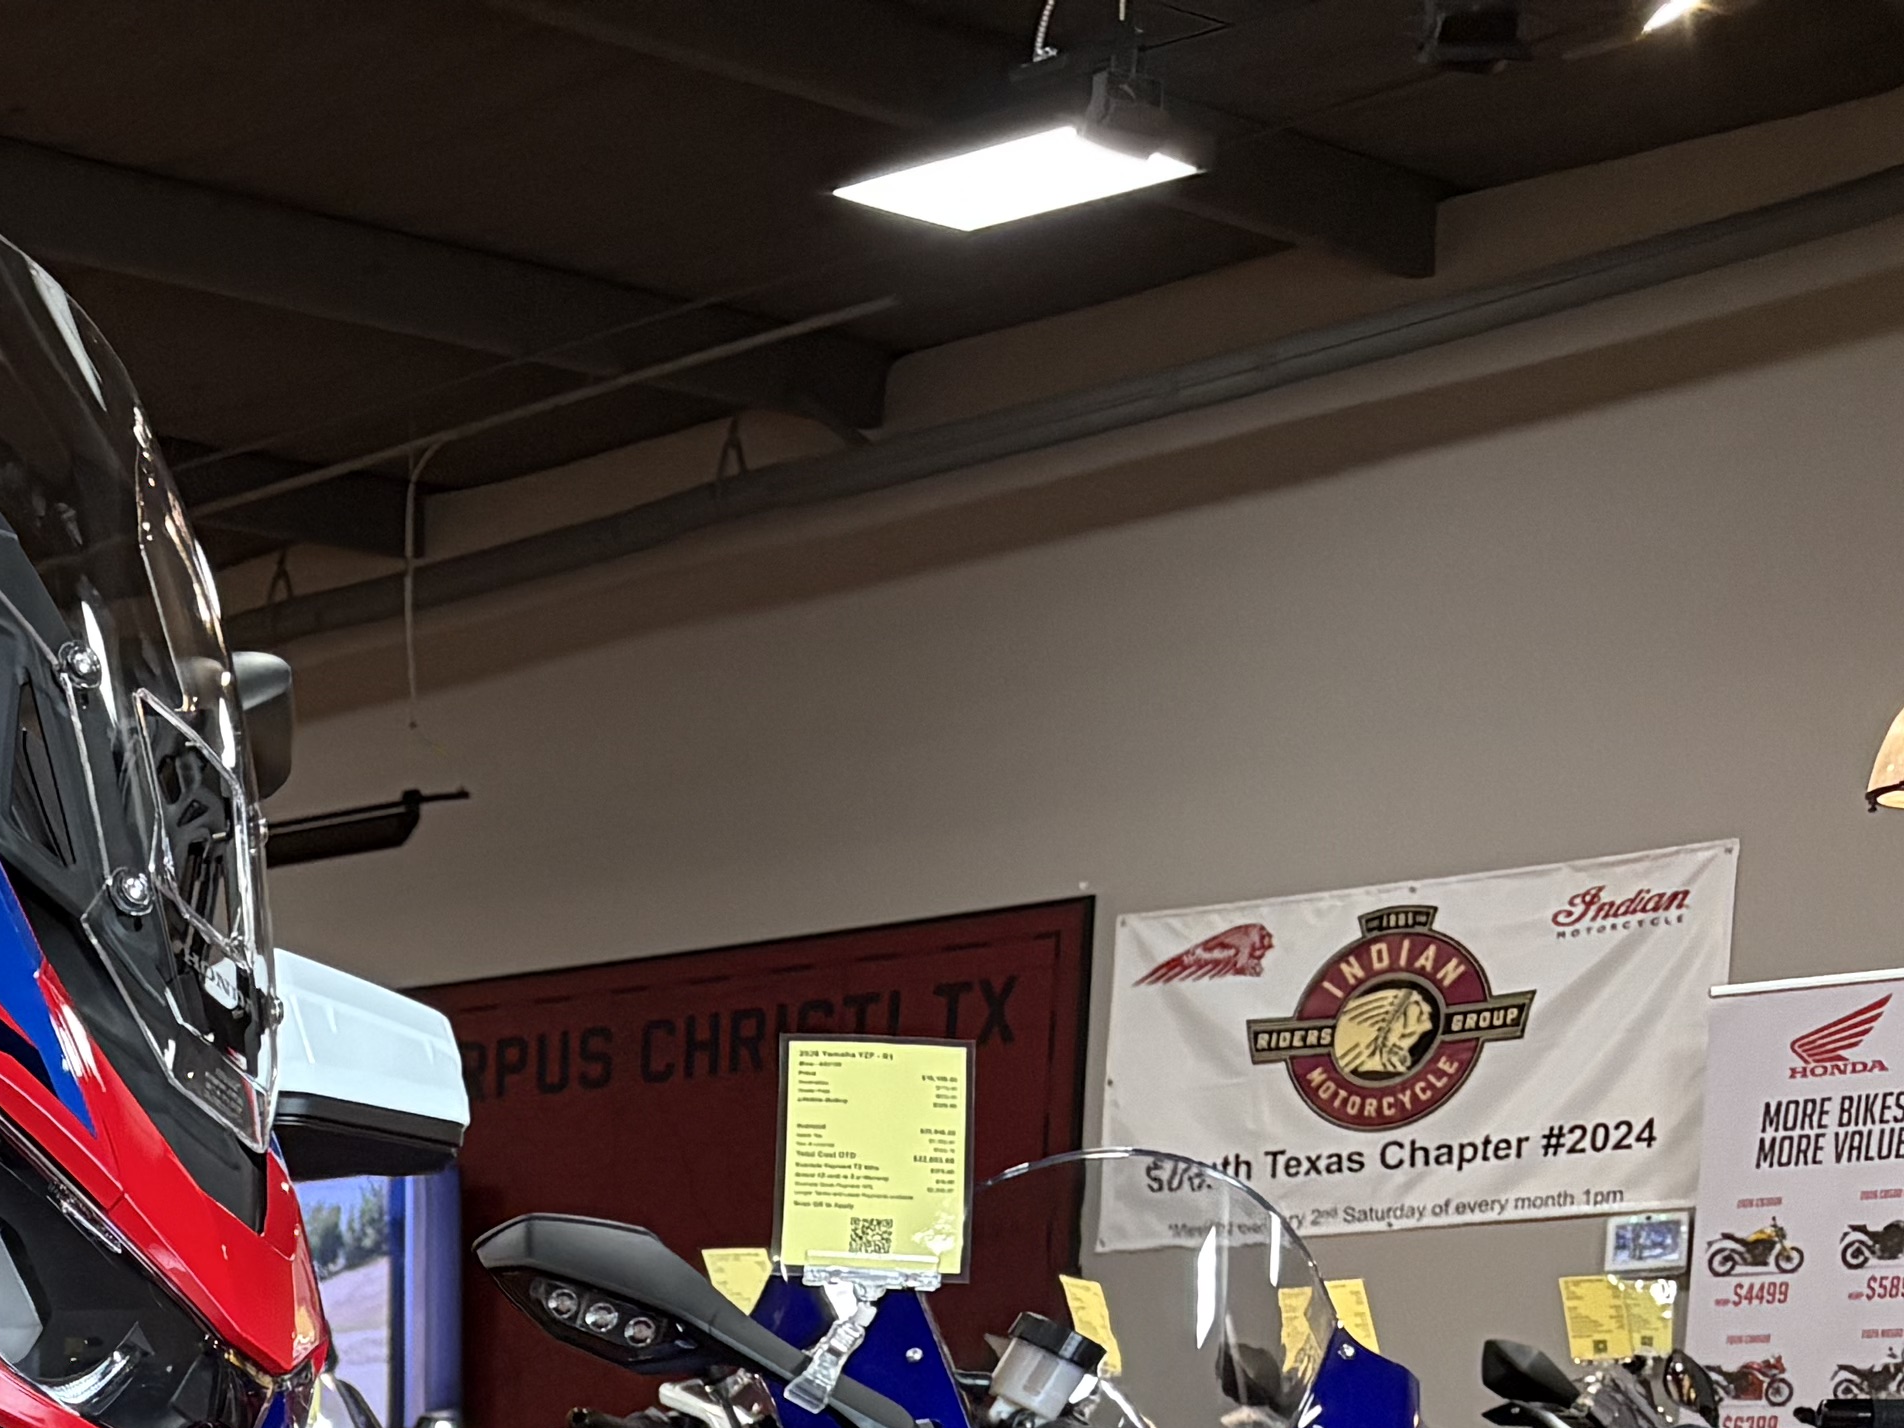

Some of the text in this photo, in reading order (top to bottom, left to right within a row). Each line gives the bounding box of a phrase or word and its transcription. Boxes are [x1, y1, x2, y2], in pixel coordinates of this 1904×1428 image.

[1551, 885, 1691, 927] Indian
[1556, 914, 1684, 940] MOTORCYCLE
[1322, 938, 1466, 999] INDIAN
[933, 976, 1018, 1045] TX
[1256, 1007, 1519, 1051] RIDERS GROUP
[1306, 1055, 1459, 1118] MOTORCYCLE
[1788, 1059, 1889, 1079] HONDA
[1761, 1096, 1833, 1133] MORE
[1145, 1117, 1657, 1193] Soth Texas Chapter #2024
[1755, 1133, 1827, 1169] MORE
[1343, 1203, 1425, 1224] Saturday
[1431, 1198, 1452, 1217] of
[1455, 1197, 1509, 1216] every
[1514, 1189, 1575, 1211] month
[1582, 1188, 1625, 1208] 1pm
[1732, 1274, 1904, 1307] $4499 $58
